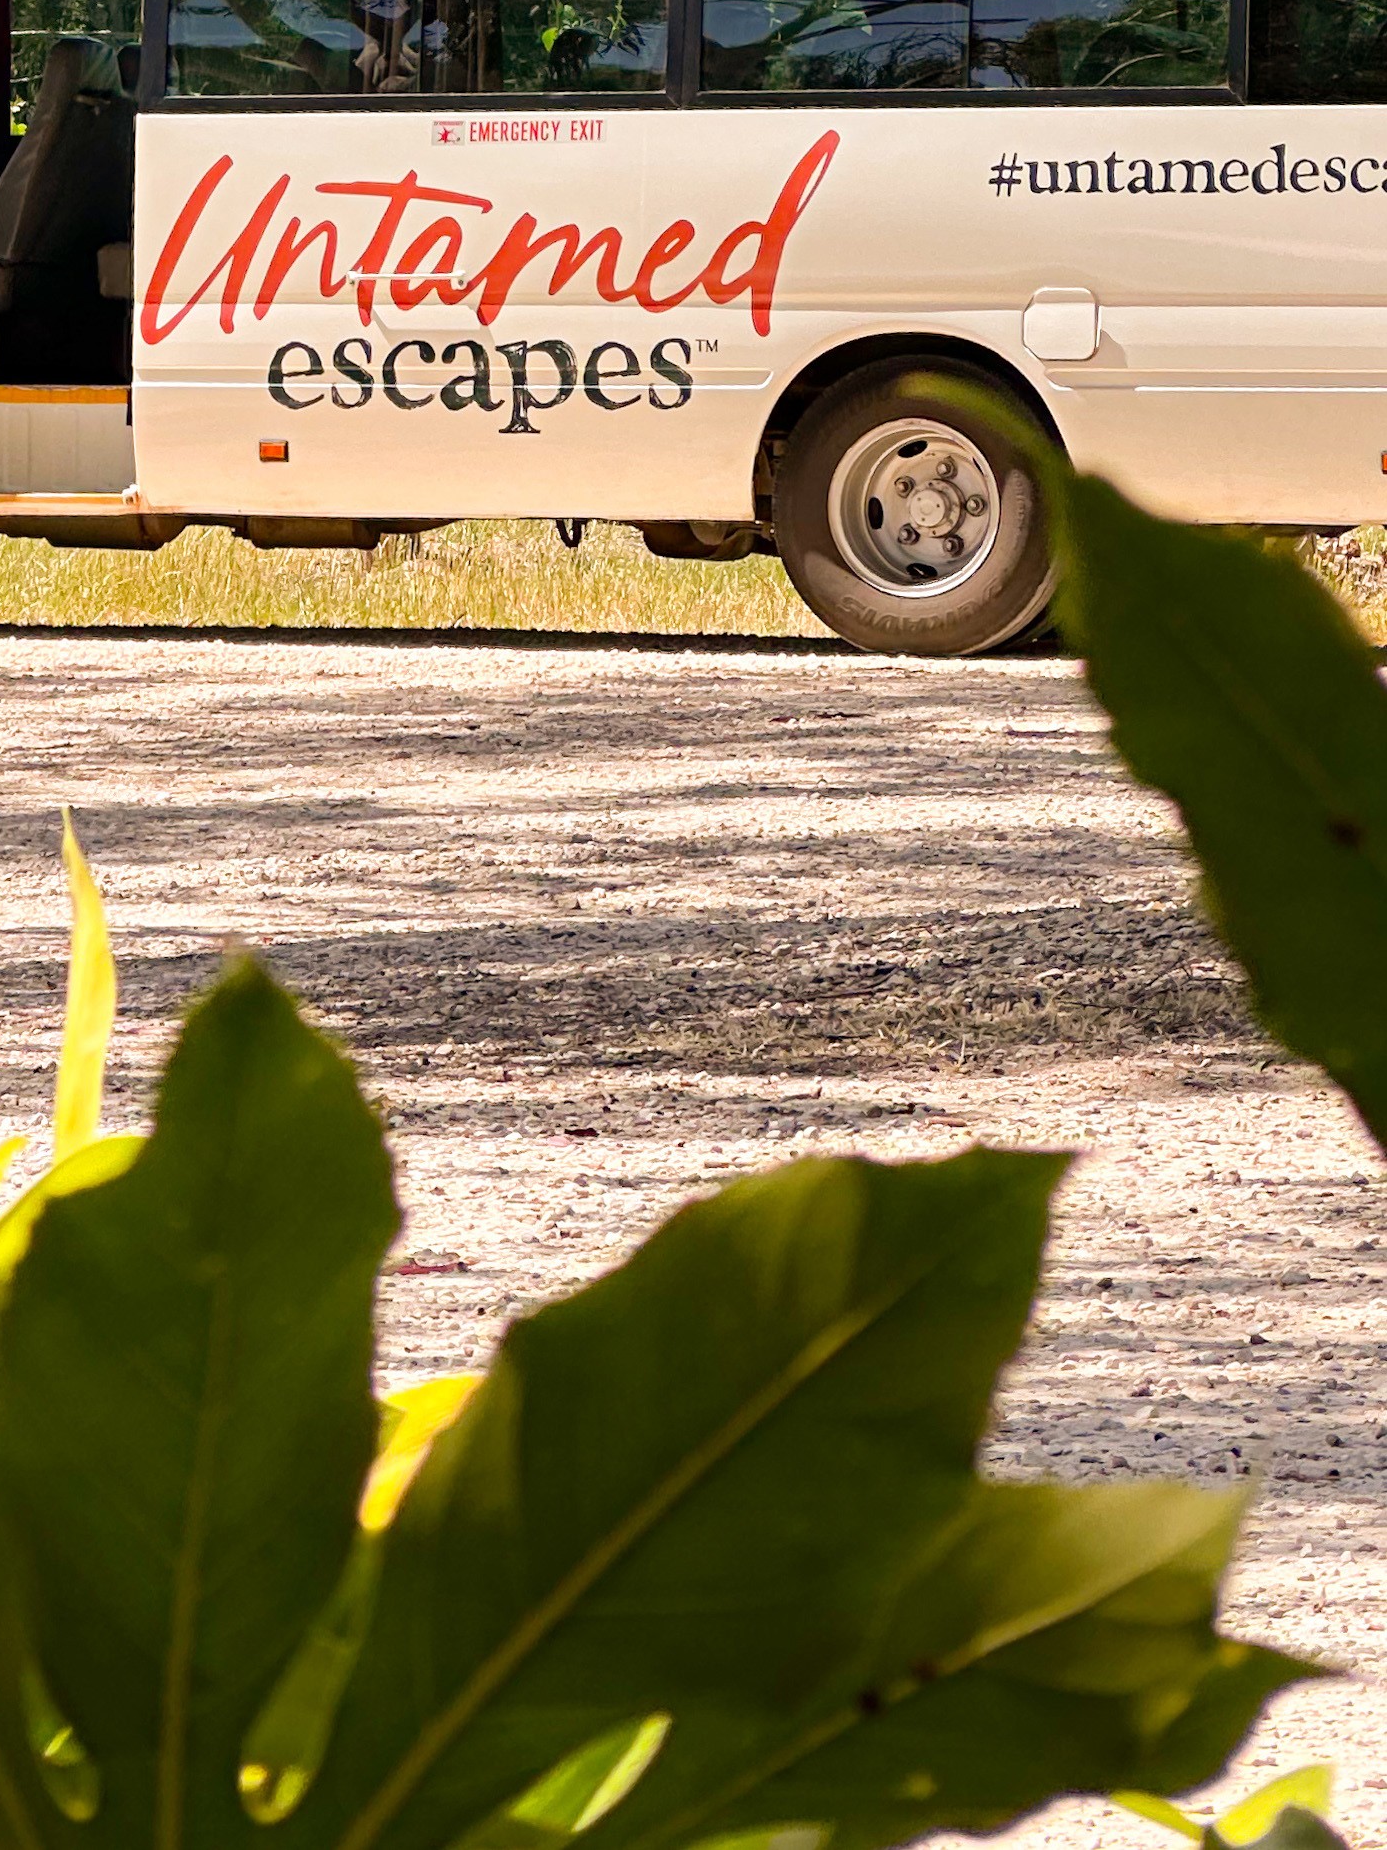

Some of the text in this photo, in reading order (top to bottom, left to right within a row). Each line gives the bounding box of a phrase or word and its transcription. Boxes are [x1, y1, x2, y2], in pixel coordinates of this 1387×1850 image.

[469, 119, 604, 142] EMERGENCY EXIT
[988, 143, 1387, 198] #untamedesc
[140, 129, 841, 346] Untamed
[267, 336, 691, 434] escapes
